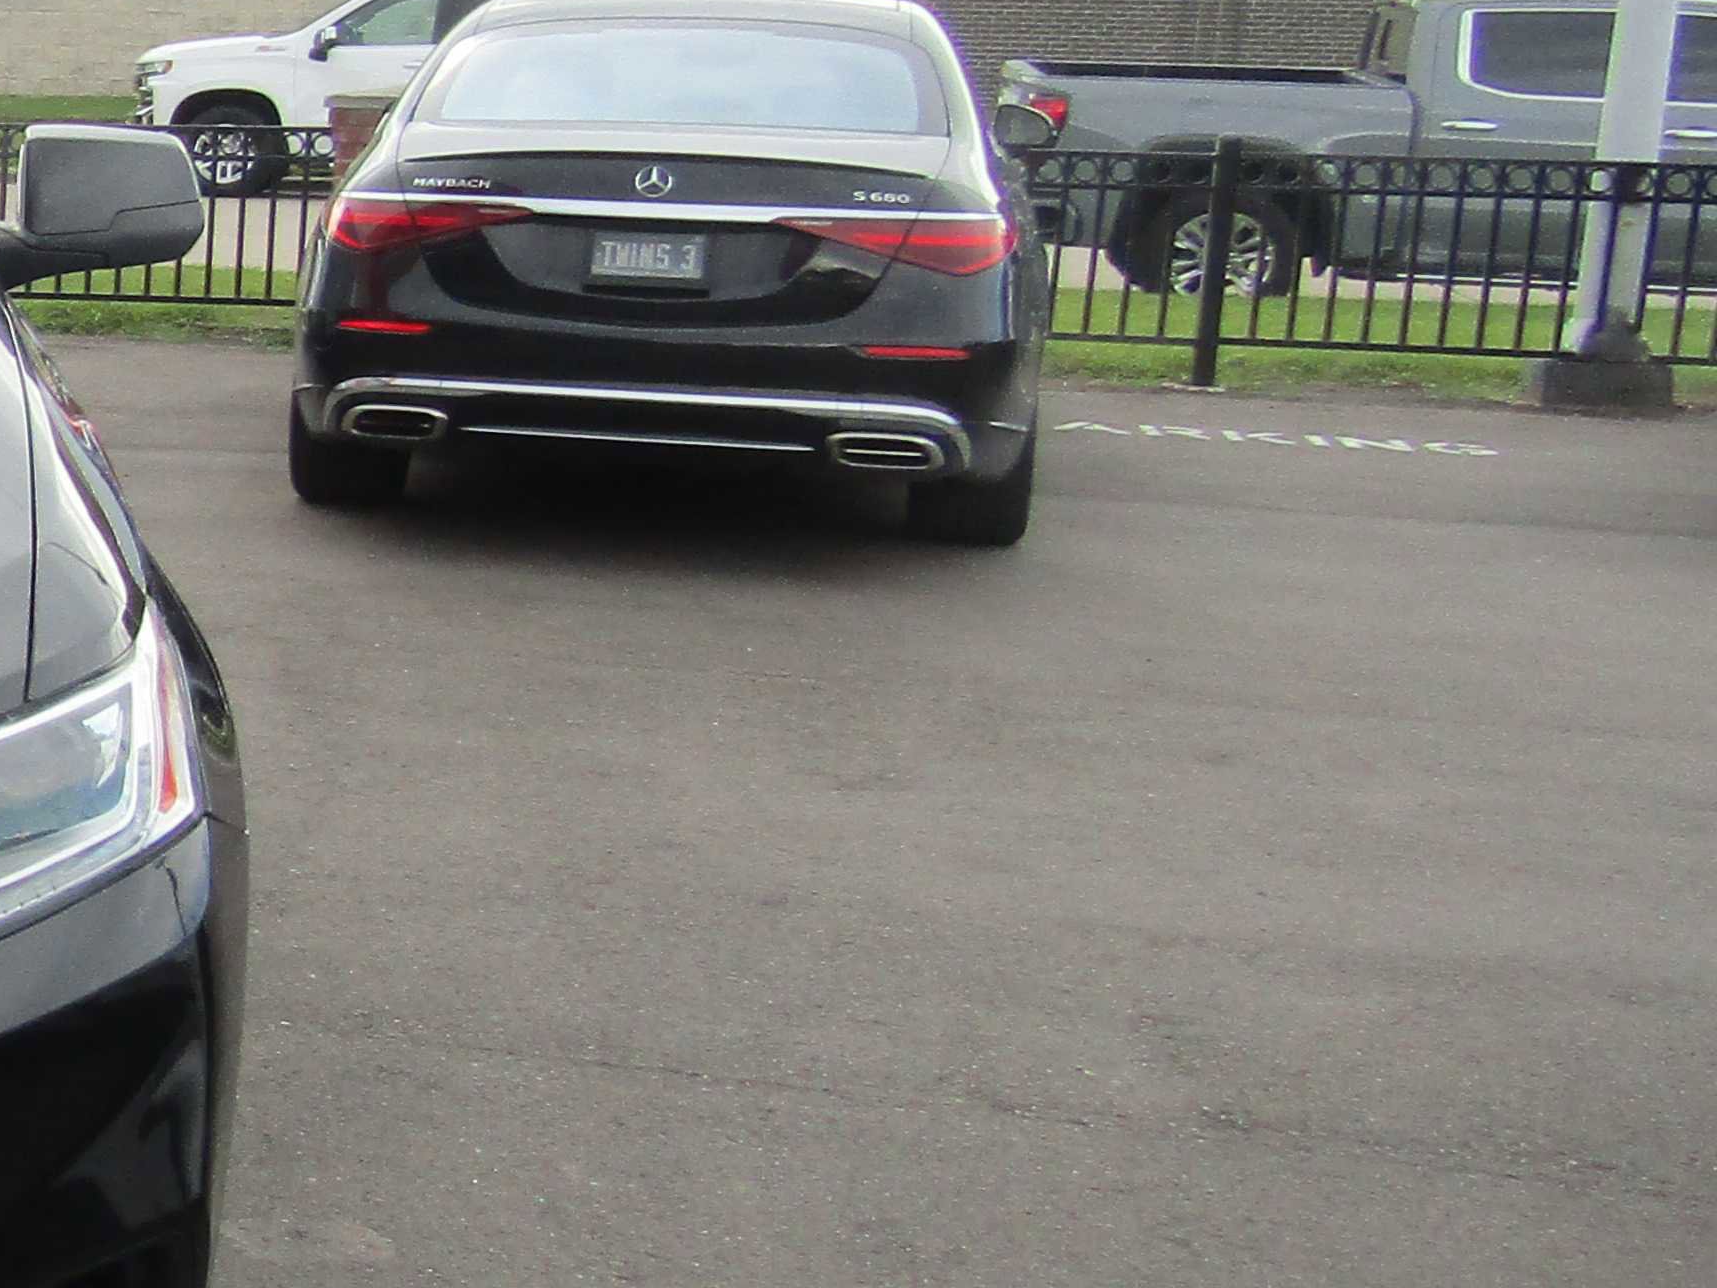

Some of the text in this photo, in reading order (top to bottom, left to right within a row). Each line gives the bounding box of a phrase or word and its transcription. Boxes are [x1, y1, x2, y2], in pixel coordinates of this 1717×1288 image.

[412, 177, 491, 189] MAYBACH
[853, 191, 865, 201] S
[1053, 421, 1499, 456] ARKING
